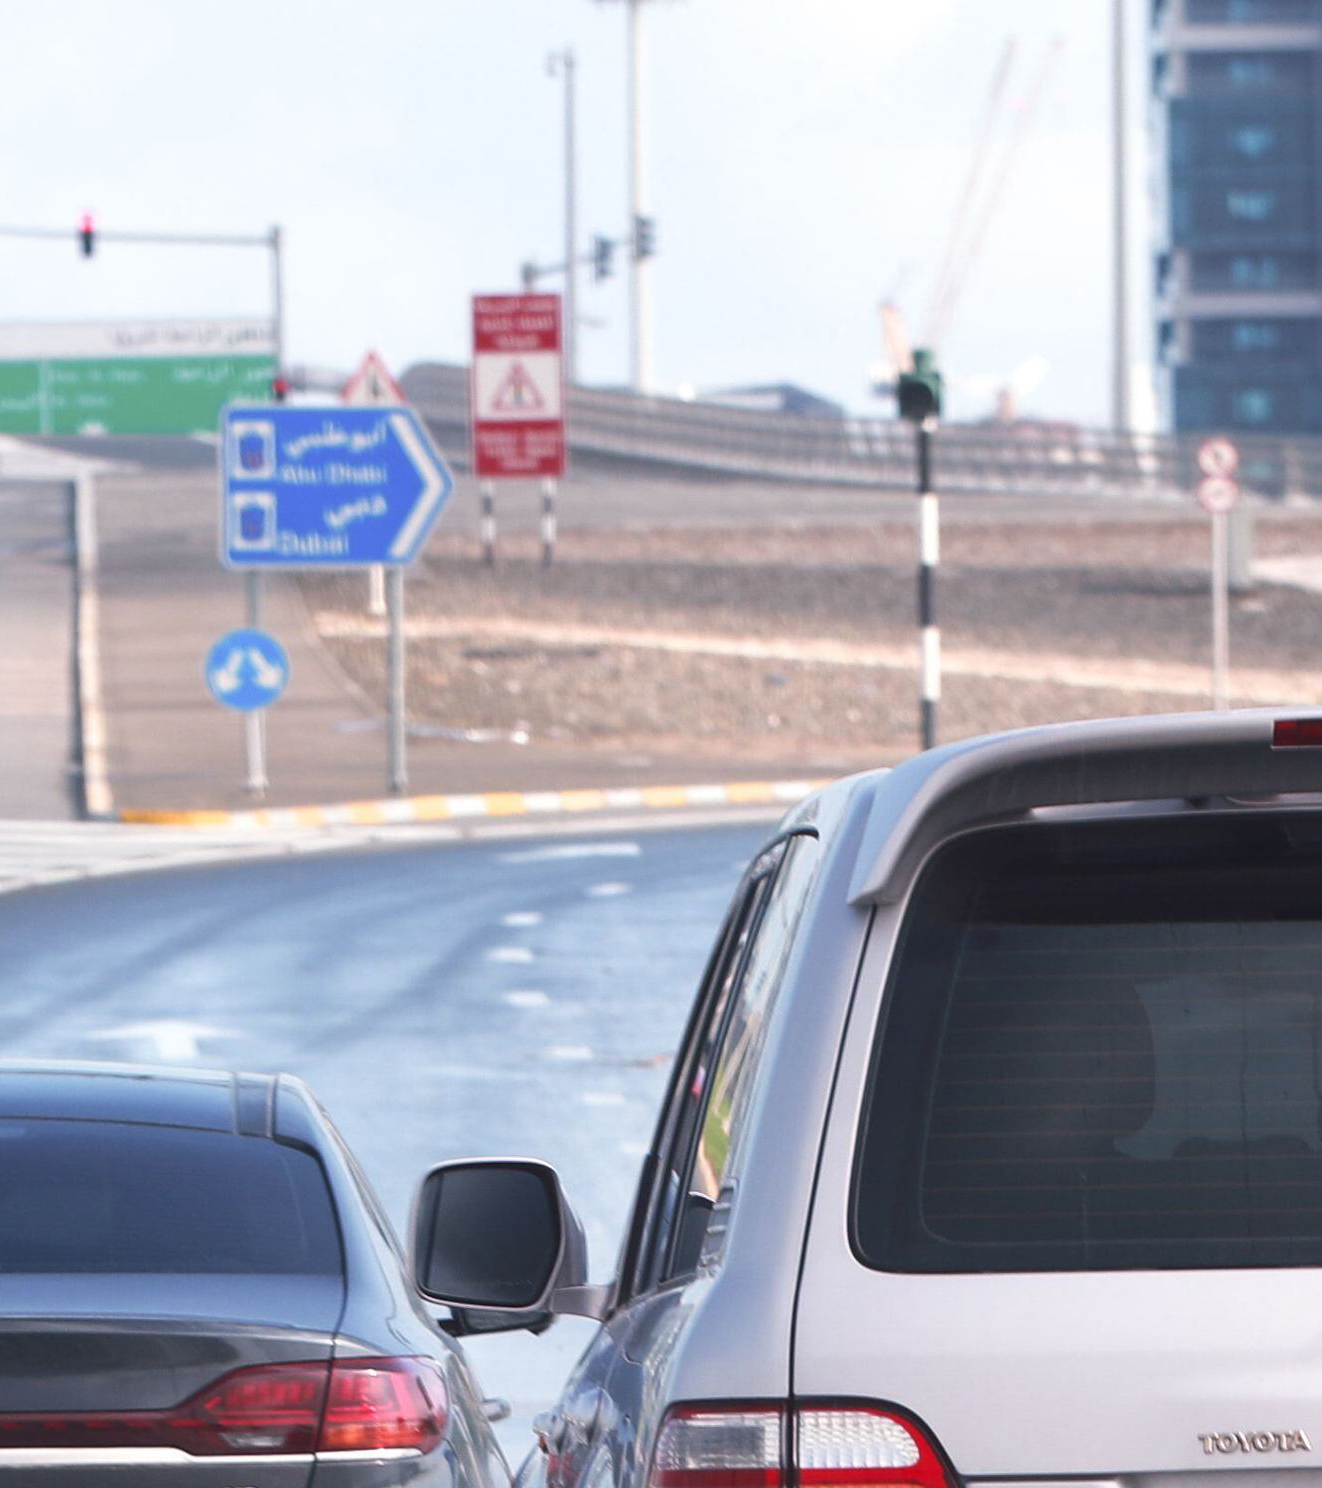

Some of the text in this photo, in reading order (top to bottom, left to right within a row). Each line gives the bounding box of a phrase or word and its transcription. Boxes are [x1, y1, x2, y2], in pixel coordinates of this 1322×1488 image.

[281, 463, 387, 485] Abu Dhabi
[280, 531, 349, 556] Dubai
[1197, 1428, 1312, 1455] TOYOTA
